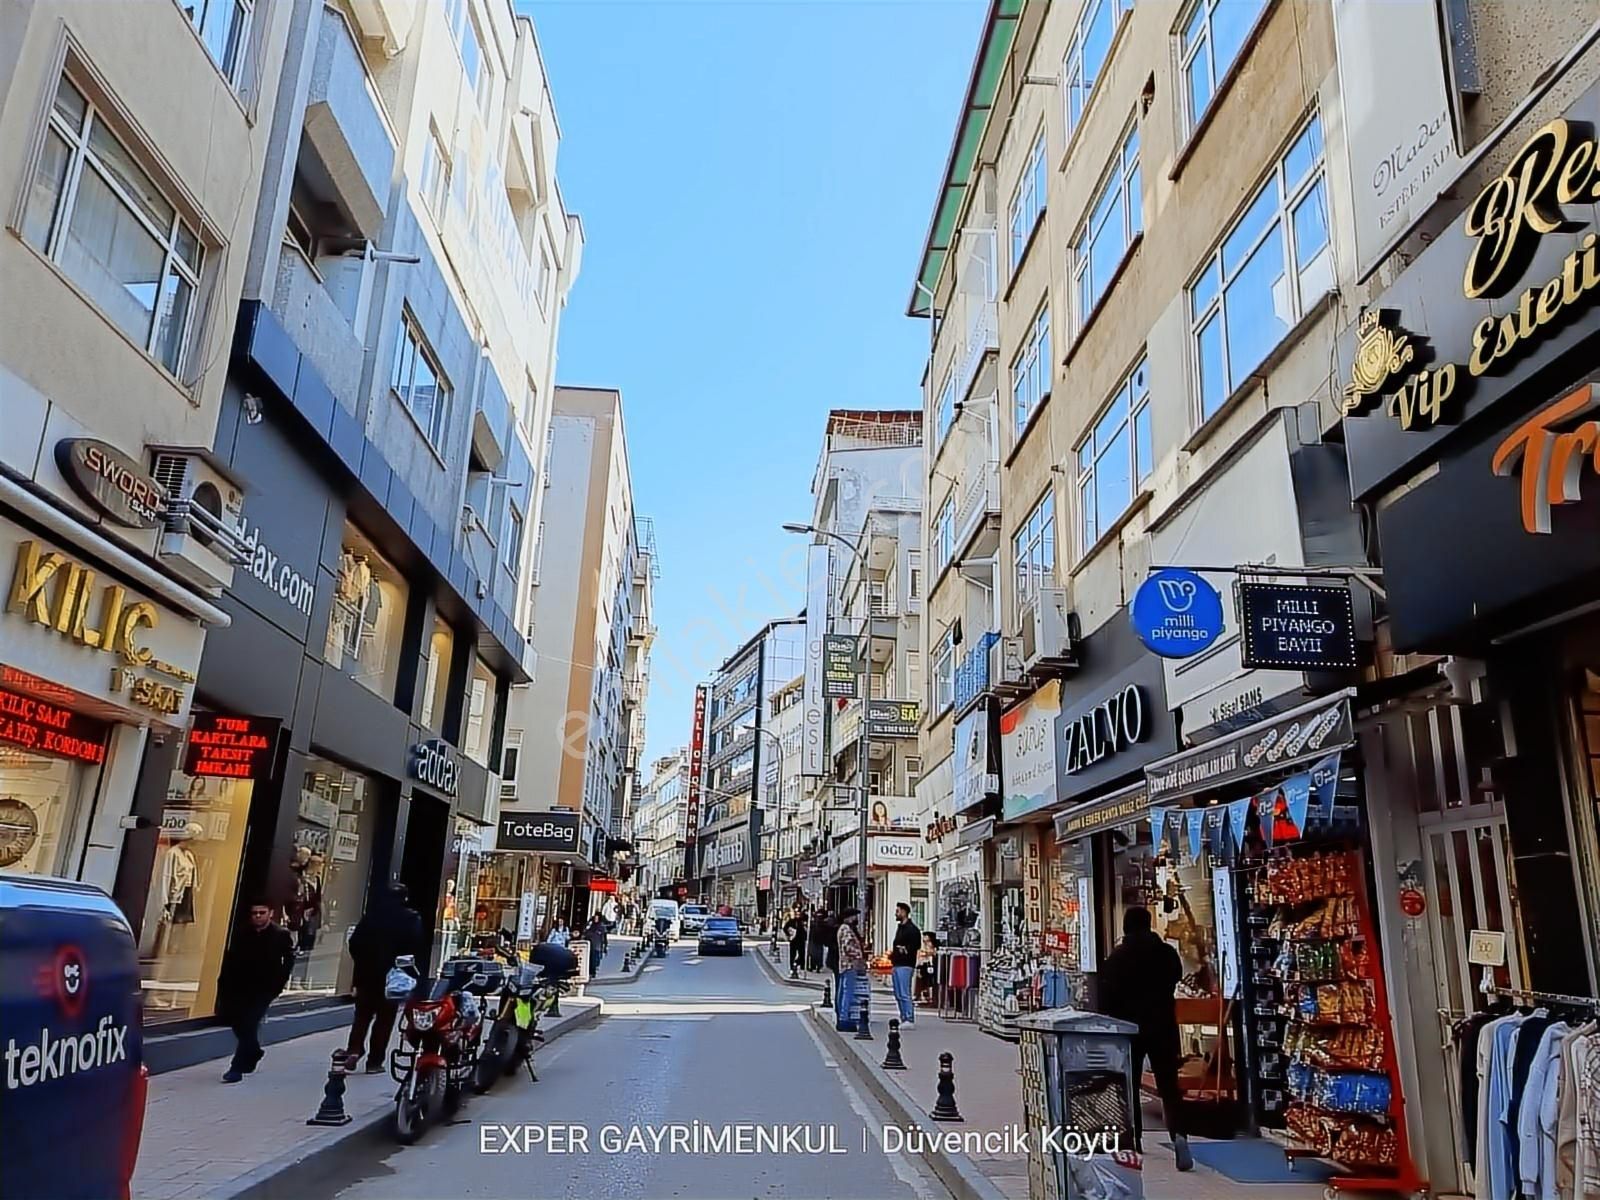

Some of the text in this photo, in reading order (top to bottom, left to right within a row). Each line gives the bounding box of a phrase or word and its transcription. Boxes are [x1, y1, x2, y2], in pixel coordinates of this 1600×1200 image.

[1463, 118, 1600, 299] Re
[1388, 363, 1456, 431] Vip
[1492, 382, 1600, 534] Tr
[83, 448, 160, 512] SWORD
[1152, 626, 1208, 641] piyango
[1165, 614, 1194, 627] milli
[1262, 617, 1335, 634] PIYANGO
[36, 704, 71, 729] SAAT
[1064, 682, 1145, 776] ZALVO
[191, 731, 269, 748] KARTLARA
[418, 740, 461, 798] addax
[503, 820, 574, 841] ToteBag
[880, 844, 914, 857] OĞUZ
[5, 1015, 128, 1090] teknofix
